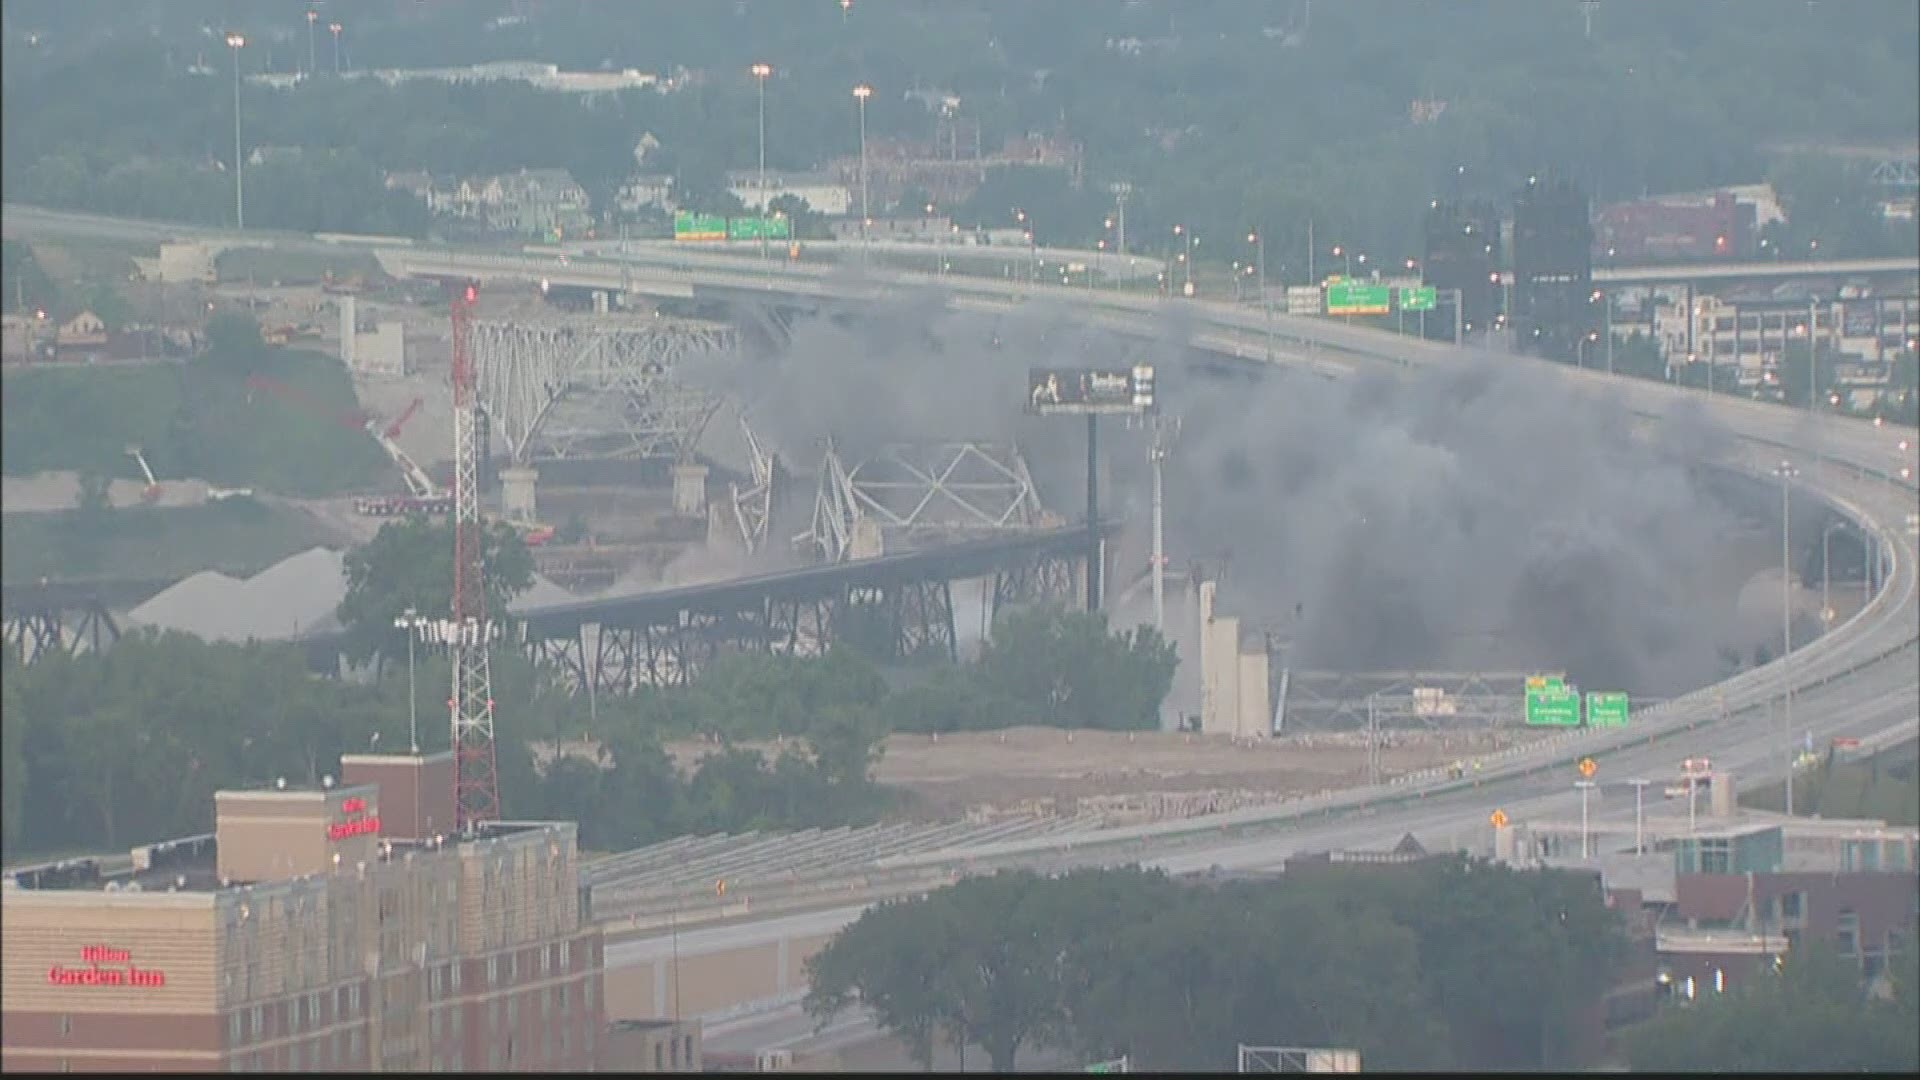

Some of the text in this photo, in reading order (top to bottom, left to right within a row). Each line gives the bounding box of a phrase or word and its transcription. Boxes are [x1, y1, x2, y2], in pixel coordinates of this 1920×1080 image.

[80, 945, 129, 961] Hilton
[47, 966, 164, 986] Garden Inn
